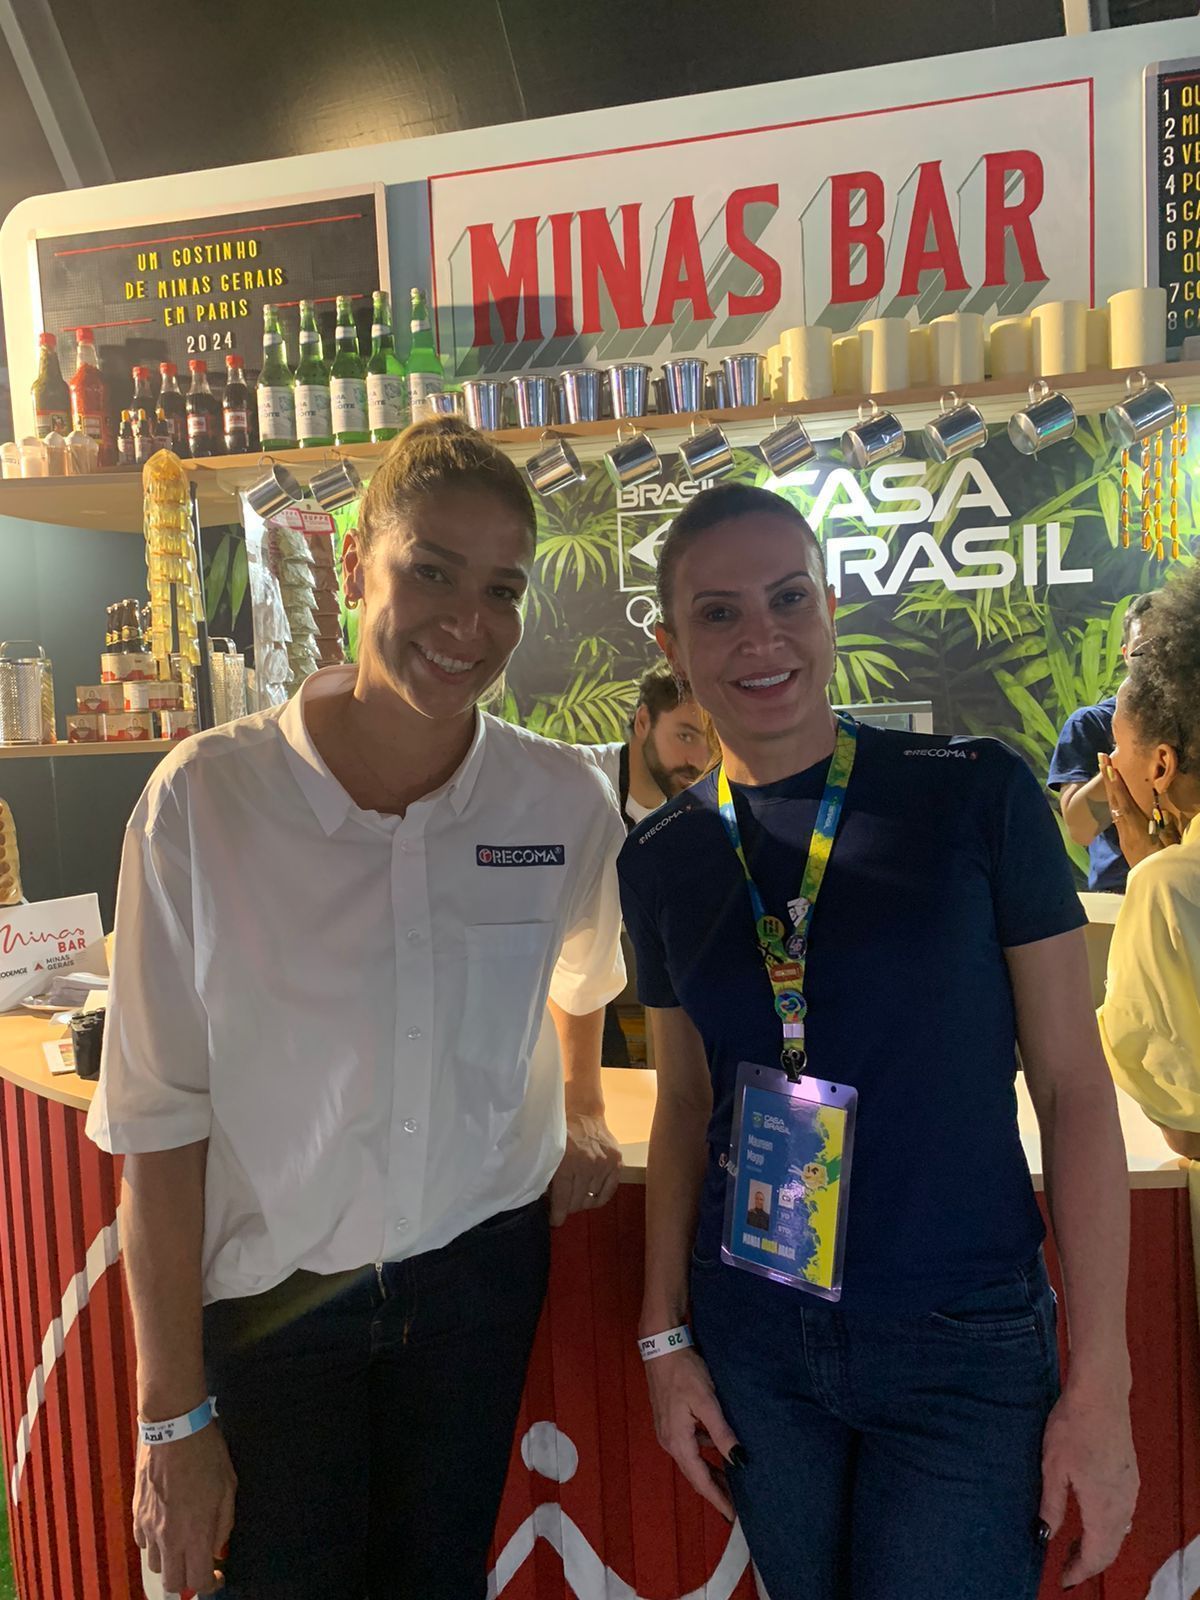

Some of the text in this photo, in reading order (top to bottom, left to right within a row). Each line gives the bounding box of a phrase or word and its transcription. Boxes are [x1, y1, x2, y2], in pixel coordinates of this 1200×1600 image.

[1163, 88, 1170, 111] 1
[1165, 117, 1176, 139] 2
[1163, 145, 1174, 167] 3
[1164, 173, 1175, 195] 4
[1166, 201, 1177, 223] 5
[465, 149, 1051, 348] MINAS BAR
[1166, 230, 1177, 251] 6
[137, 239, 258, 272] UM GOSTINHO
[125, 267, 284, 300] DE MINAS GERAIS
[1170, 282, 1180, 303] 7
[164, 298, 249, 327] EM PARIS
[1168, 310, 1177, 330] 8
[186, 331, 233, 354] 2024
[826, 522, 1094, 599] RASIL
[491, 849, 558, 864] RECOMA
[57, 937, 87, 953] BAR
[46, 954, 71, 965] MINAS
[47, 959, 75, 971] GERAIS
[0, 966, 28, 979] ODEMGE
[667, 1332, 684, 1346] 28
[145, 1431, 163, 1441] Azul
